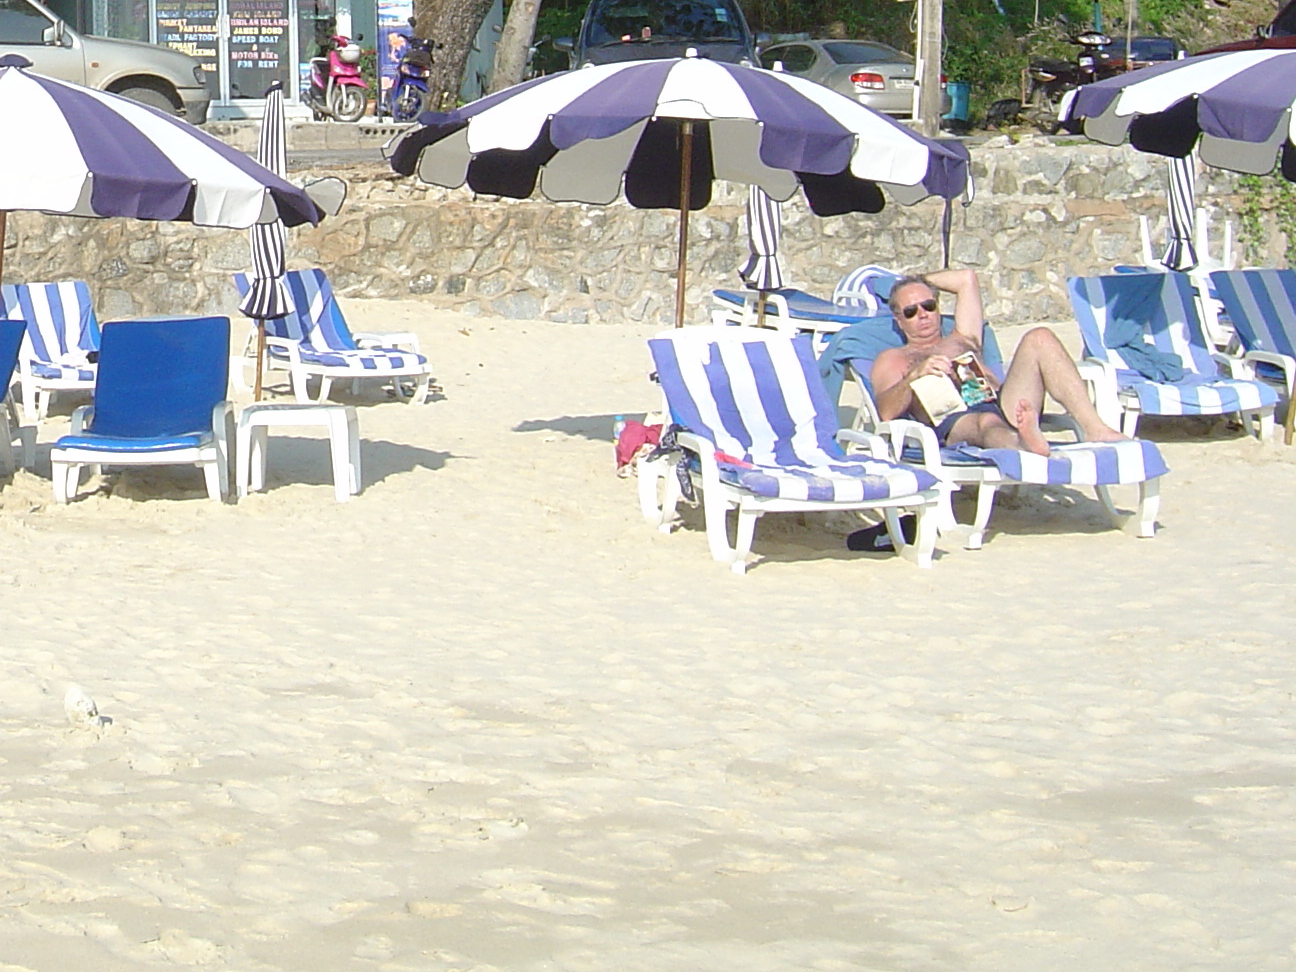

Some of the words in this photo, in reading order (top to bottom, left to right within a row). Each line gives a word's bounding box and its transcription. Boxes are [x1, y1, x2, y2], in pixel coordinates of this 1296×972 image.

[260, 18, 289, 26] ISLAND
[232, 35, 256, 43] SPEED
[258, 35, 279, 43] BOAT
[231, 51, 259, 59] MOTOR
[237, 60, 253, 68] FOR
[258, 60, 279, 68] RENT
